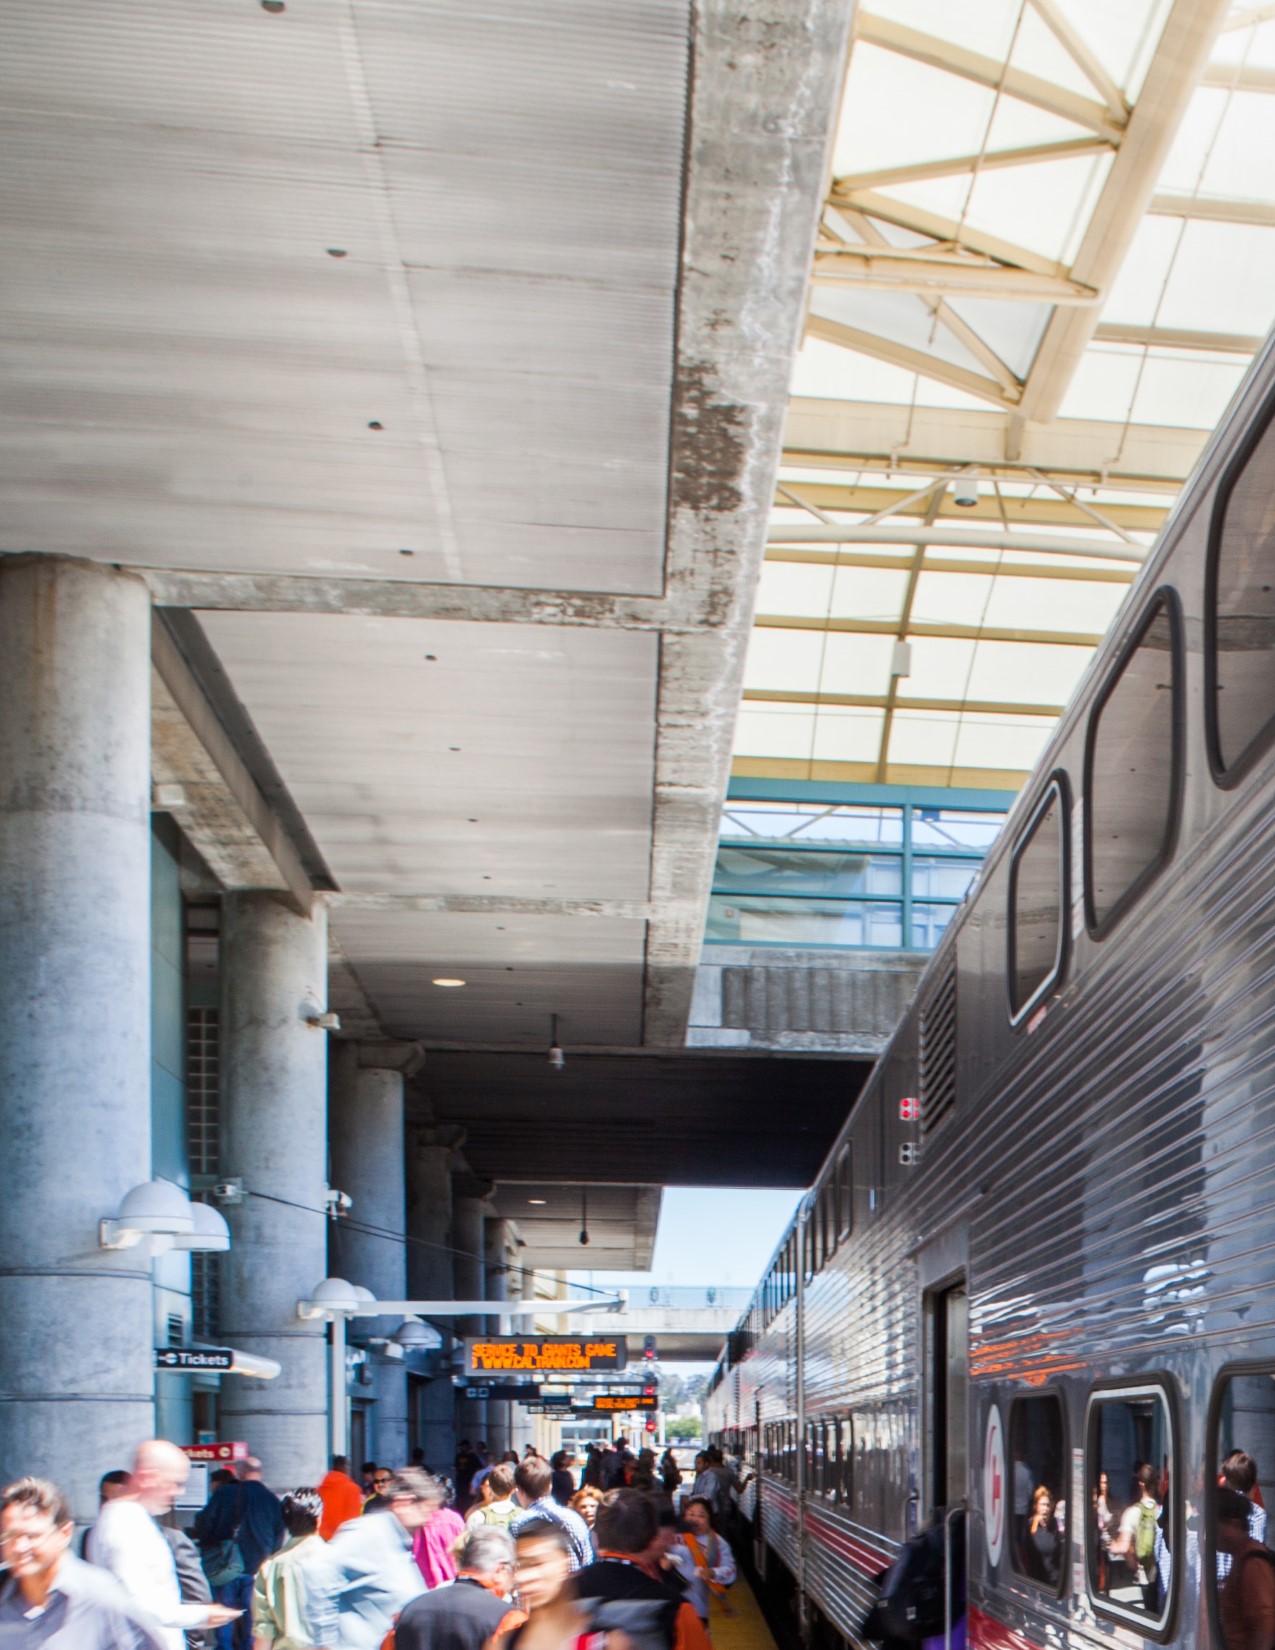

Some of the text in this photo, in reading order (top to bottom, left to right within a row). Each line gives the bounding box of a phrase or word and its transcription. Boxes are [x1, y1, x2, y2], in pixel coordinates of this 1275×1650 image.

[521, 1343, 539, 1357] TO
[584, 1343, 617, 1357] GAME
[178, 1352, 229, 1366] Tickets
